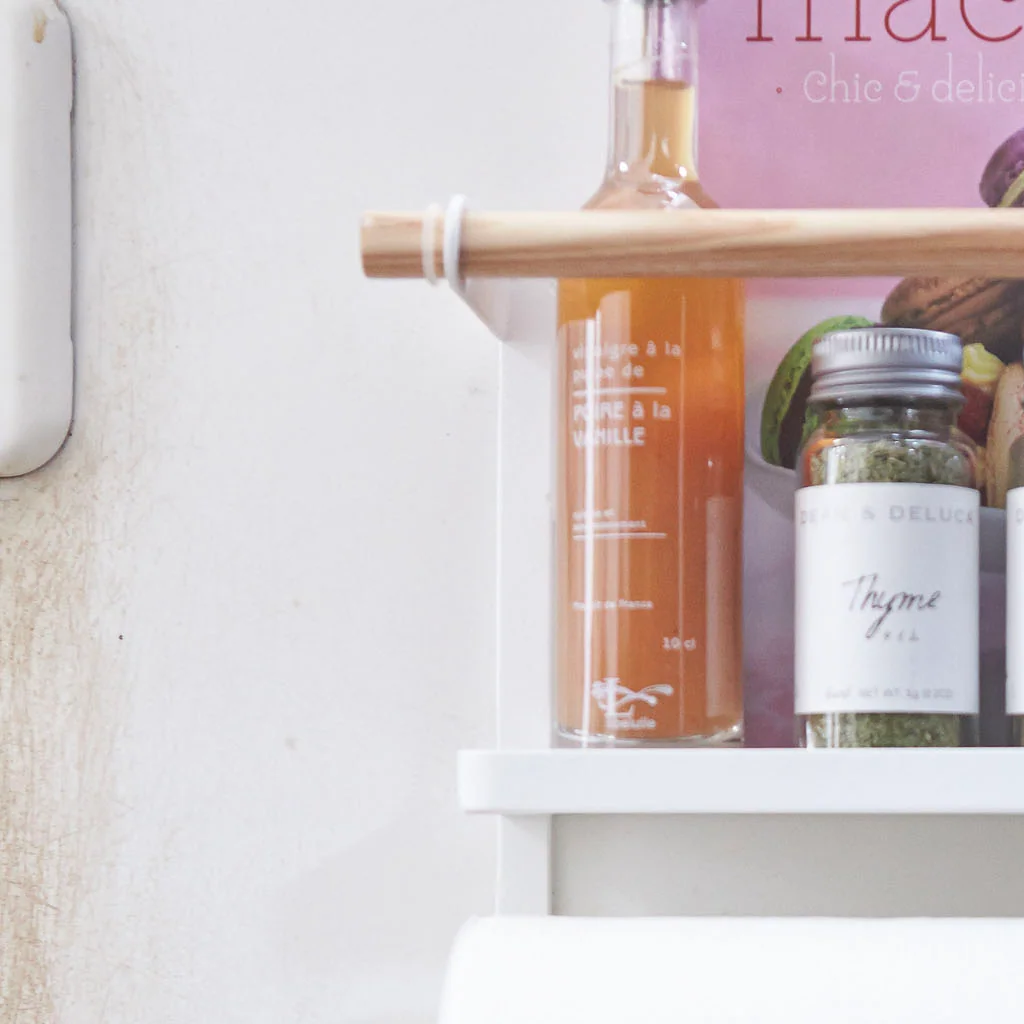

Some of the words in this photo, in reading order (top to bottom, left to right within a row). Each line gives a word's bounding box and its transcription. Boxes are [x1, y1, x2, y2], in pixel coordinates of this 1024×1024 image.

[802, 51, 884, 104] Chic
[894, 70, 921, 102] &
[841, 572, 942, 640] Thyme
